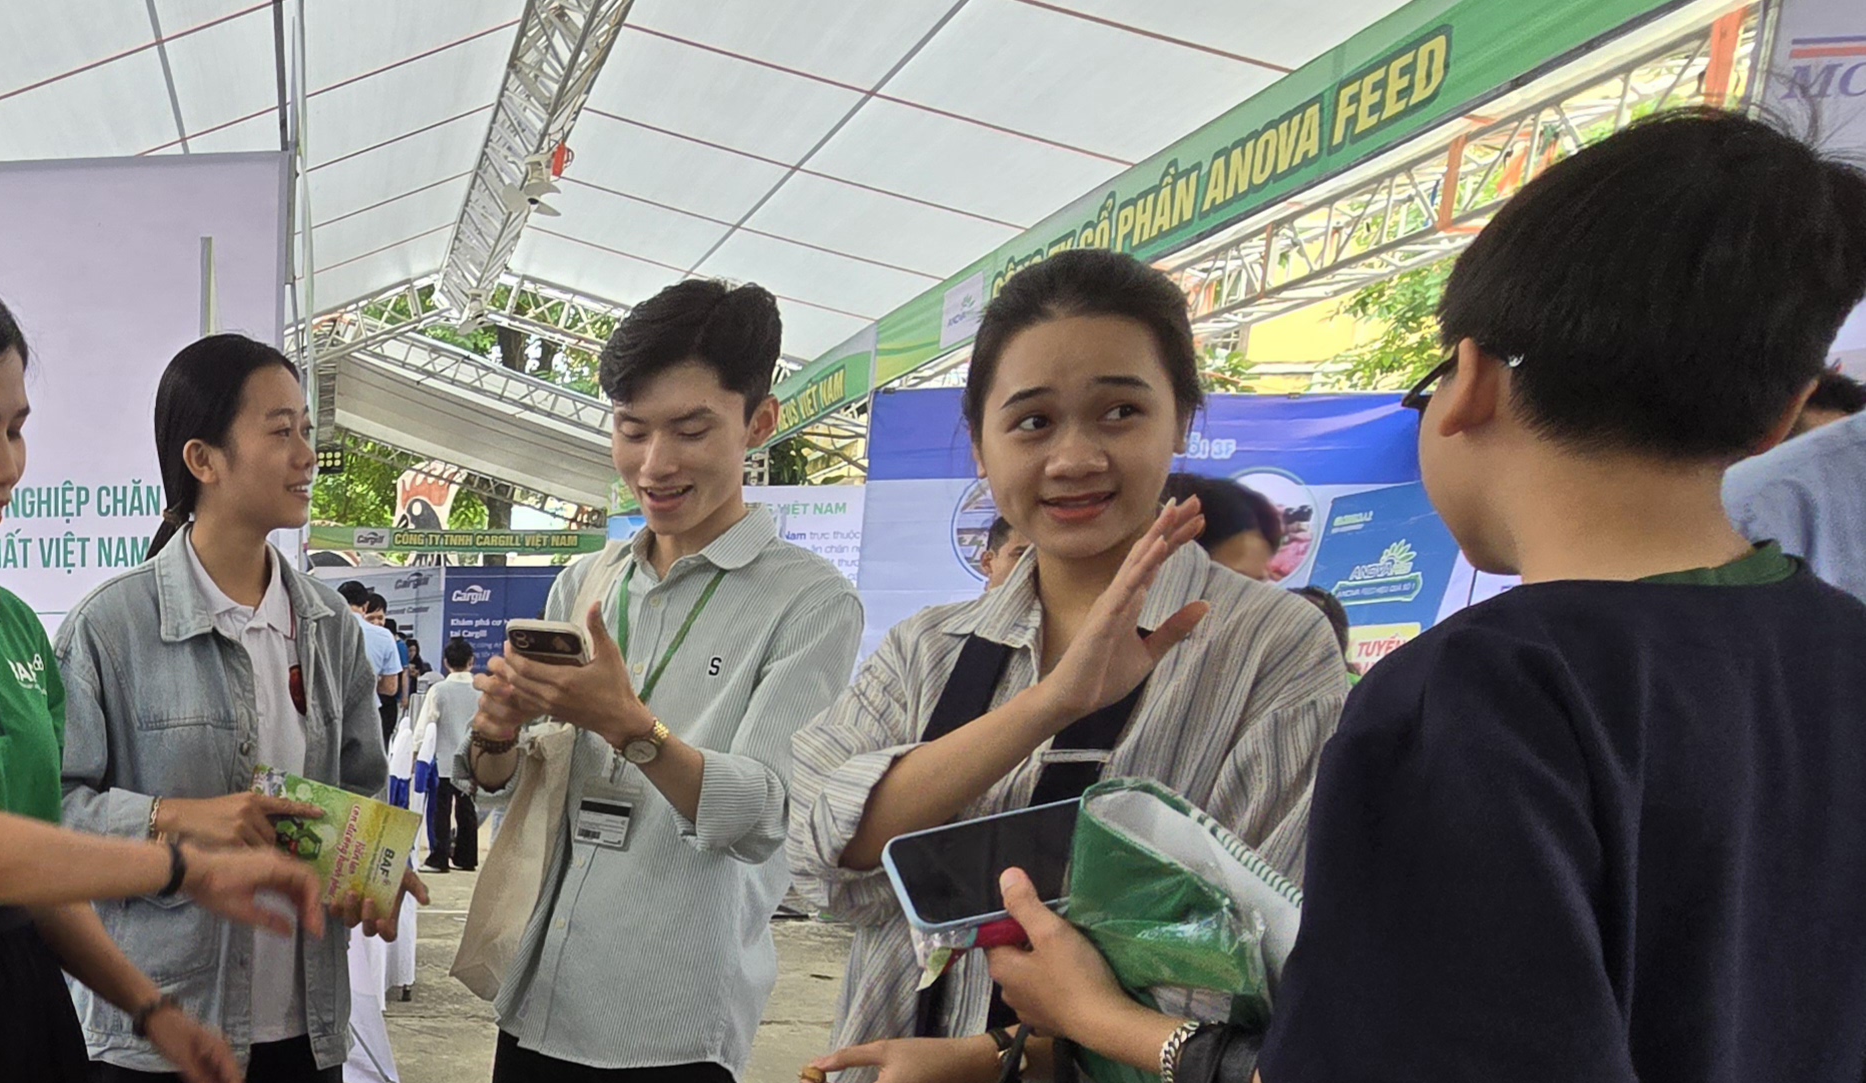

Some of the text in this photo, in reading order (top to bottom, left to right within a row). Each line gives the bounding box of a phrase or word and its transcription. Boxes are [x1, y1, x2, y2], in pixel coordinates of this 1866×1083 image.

[1117, 158, 1198, 252] PHẦN
[1201, 102, 1321, 213] ANOVA
[1333, 33, 1446, 146] FEED
[819, 369, 845, 407] NAM
[5, 478, 162, 524] NGHIỆP CHĂN
[813, 502, 847, 515] NAM
[356, 532, 385, 546] Cargill
[427, 533, 442, 546] TY
[443, 533, 473, 547] TNHH
[475, 534, 522, 547] CARGILL
[524, 533, 549, 550] VIỆT
[550, 535, 578, 547] NAM
[38, 531, 91, 574] VIỆT
[97, 536, 150, 568] NAM
[451, 587, 492, 605] Cargill
[708, 656, 722, 676] S
[378, 848, 395, 878] BAF
